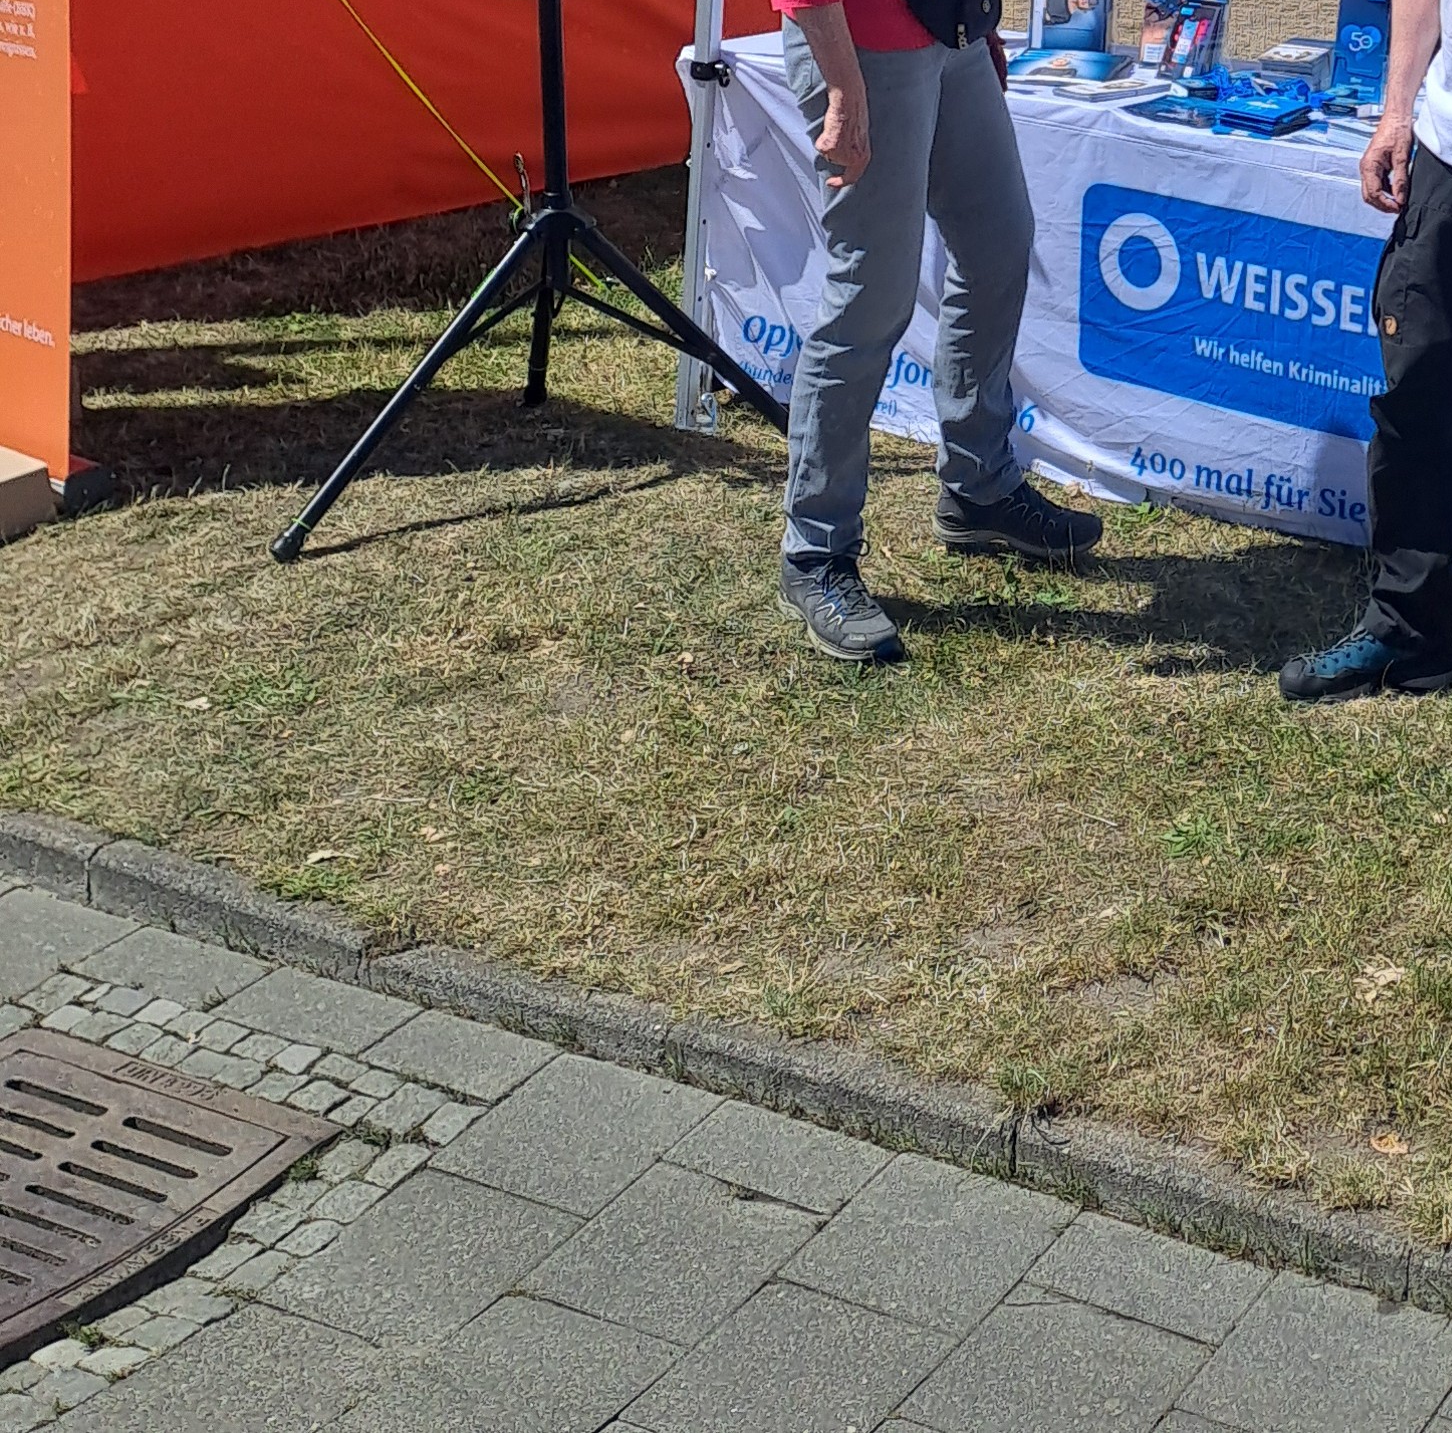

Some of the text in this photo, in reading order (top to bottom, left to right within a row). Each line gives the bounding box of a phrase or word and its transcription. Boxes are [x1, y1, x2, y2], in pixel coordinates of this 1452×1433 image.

[1349, 31, 1373, 51] 50
[1193, 336, 1224, 362] Wir
[1229, 347, 1285, 378] helfen
[1129, 446, 1187, 482] 400
[1195, 463, 1254, 499] mal
[1260, 473, 1310, 512] für
[1318, 487, 1367, 523] Sie
